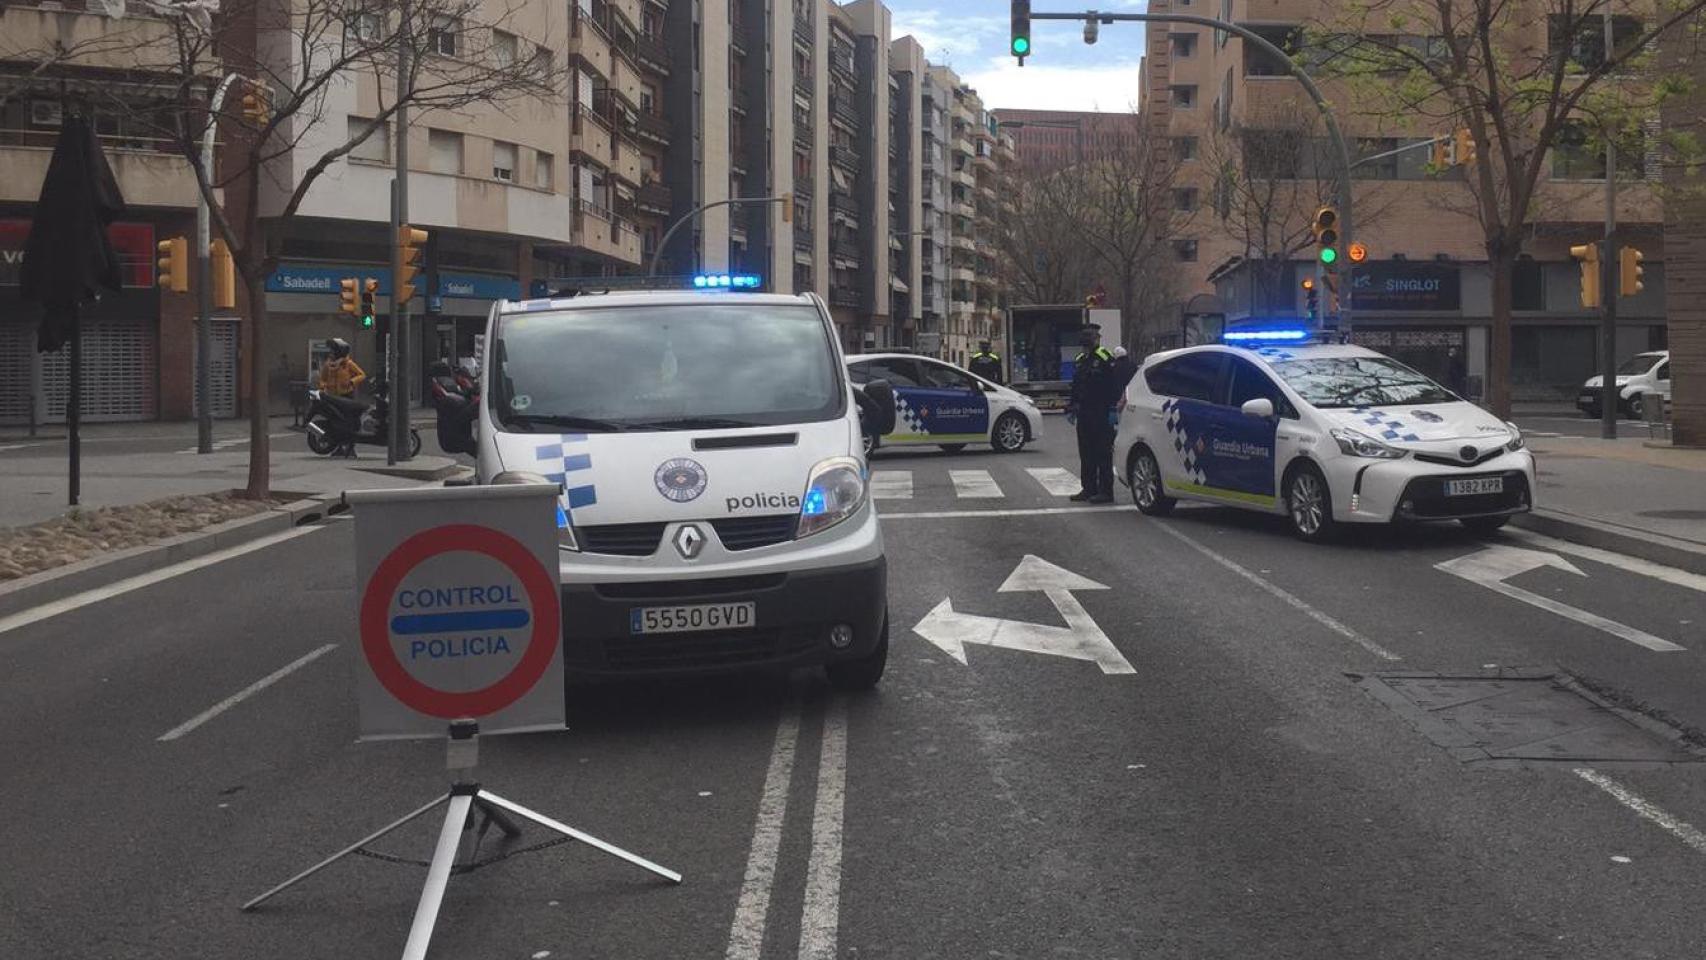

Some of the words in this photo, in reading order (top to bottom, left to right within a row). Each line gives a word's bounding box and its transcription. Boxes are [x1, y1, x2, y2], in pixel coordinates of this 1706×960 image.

[283, 275, 331, 289] Sabadell
[1385, 279, 1441, 292] SINGLOT
[1212, 438, 1240, 453] Guardia
[1241, 443, 1269, 457] Urbana
[726, 492, 800, 512] policia
[399, 585, 520, 609] CONTROL
[411, 635, 511, 660] POLICIA
